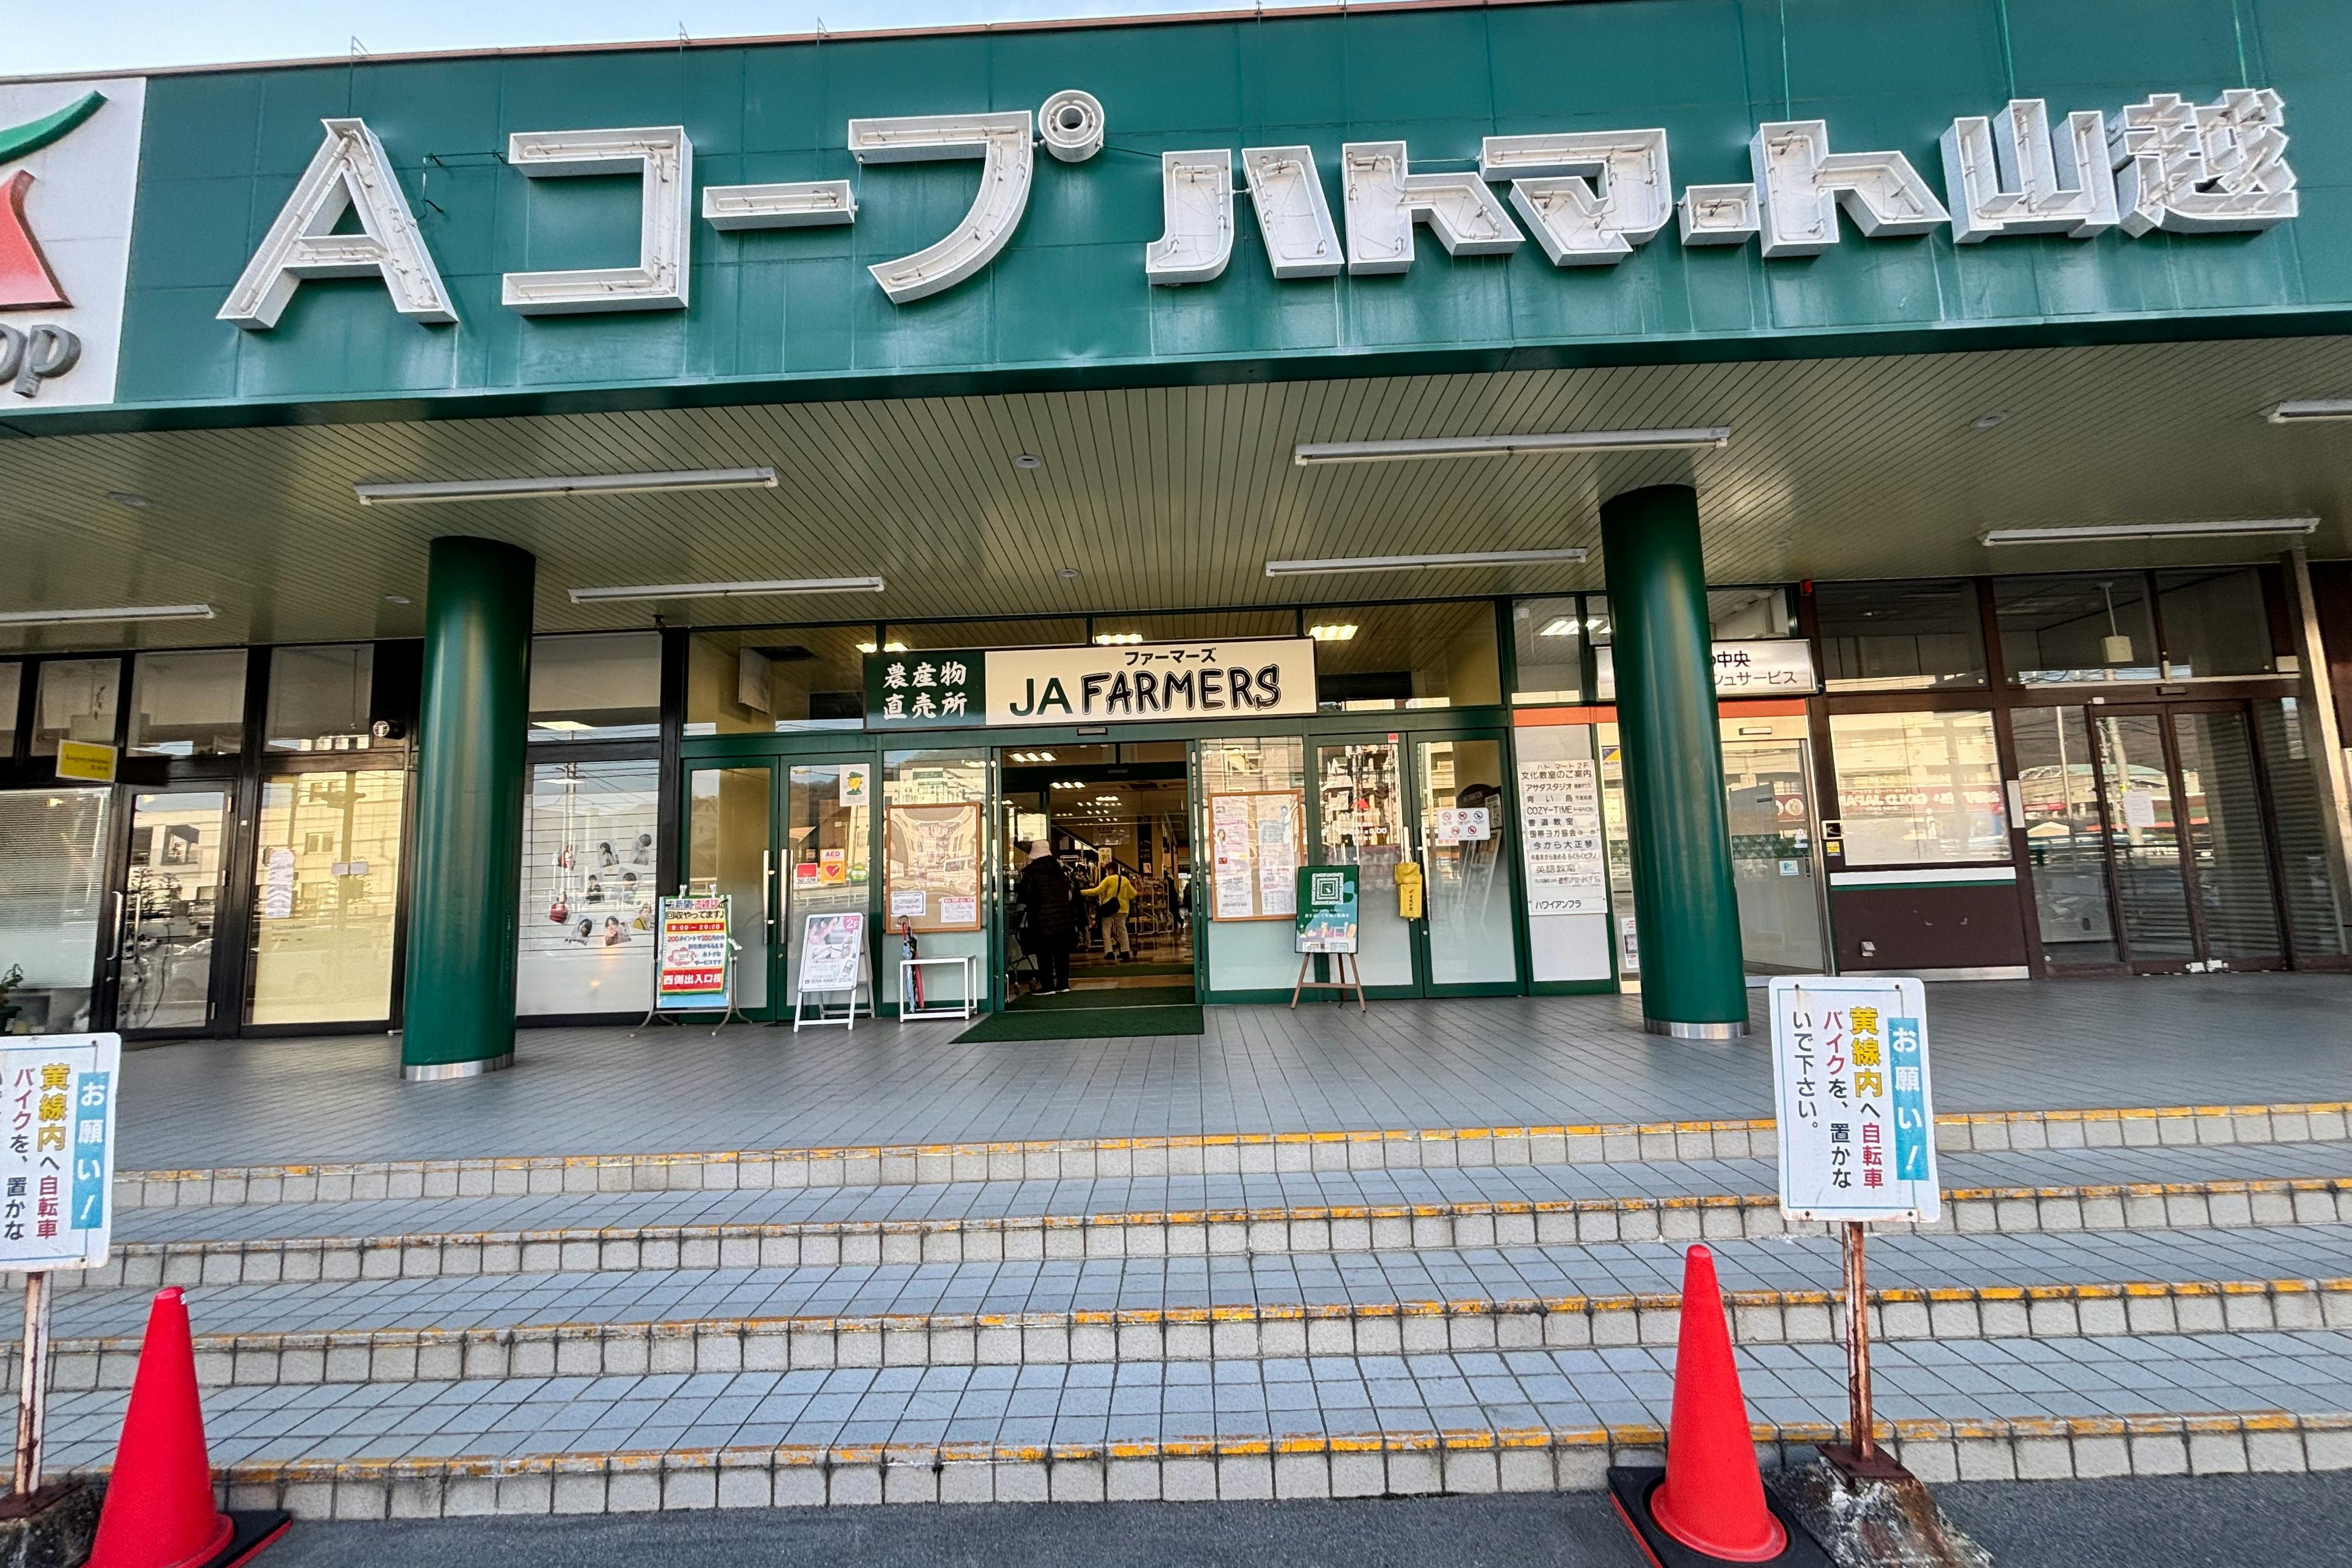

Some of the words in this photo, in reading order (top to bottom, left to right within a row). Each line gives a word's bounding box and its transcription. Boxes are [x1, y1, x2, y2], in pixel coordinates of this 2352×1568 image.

[1125, 647, 1217, 666] ファーマーズ
[883, 661, 967, 690] 農産物
[1010, 678, 1073, 716] JA
[1080, 664, 1281, 715] FARMERS
[883, 691, 968, 720] 直売所
[1521, 770, 1591, 780] 文化教室のご案内
[1526, 783, 1572, 792] アサダスタジオ
[1527, 806, 1573, 814] COZY-TIME
[1535, 900, 1581, 909] ハワイアンフラ
[1793, 1011, 1819, 1129] いで下さい。
